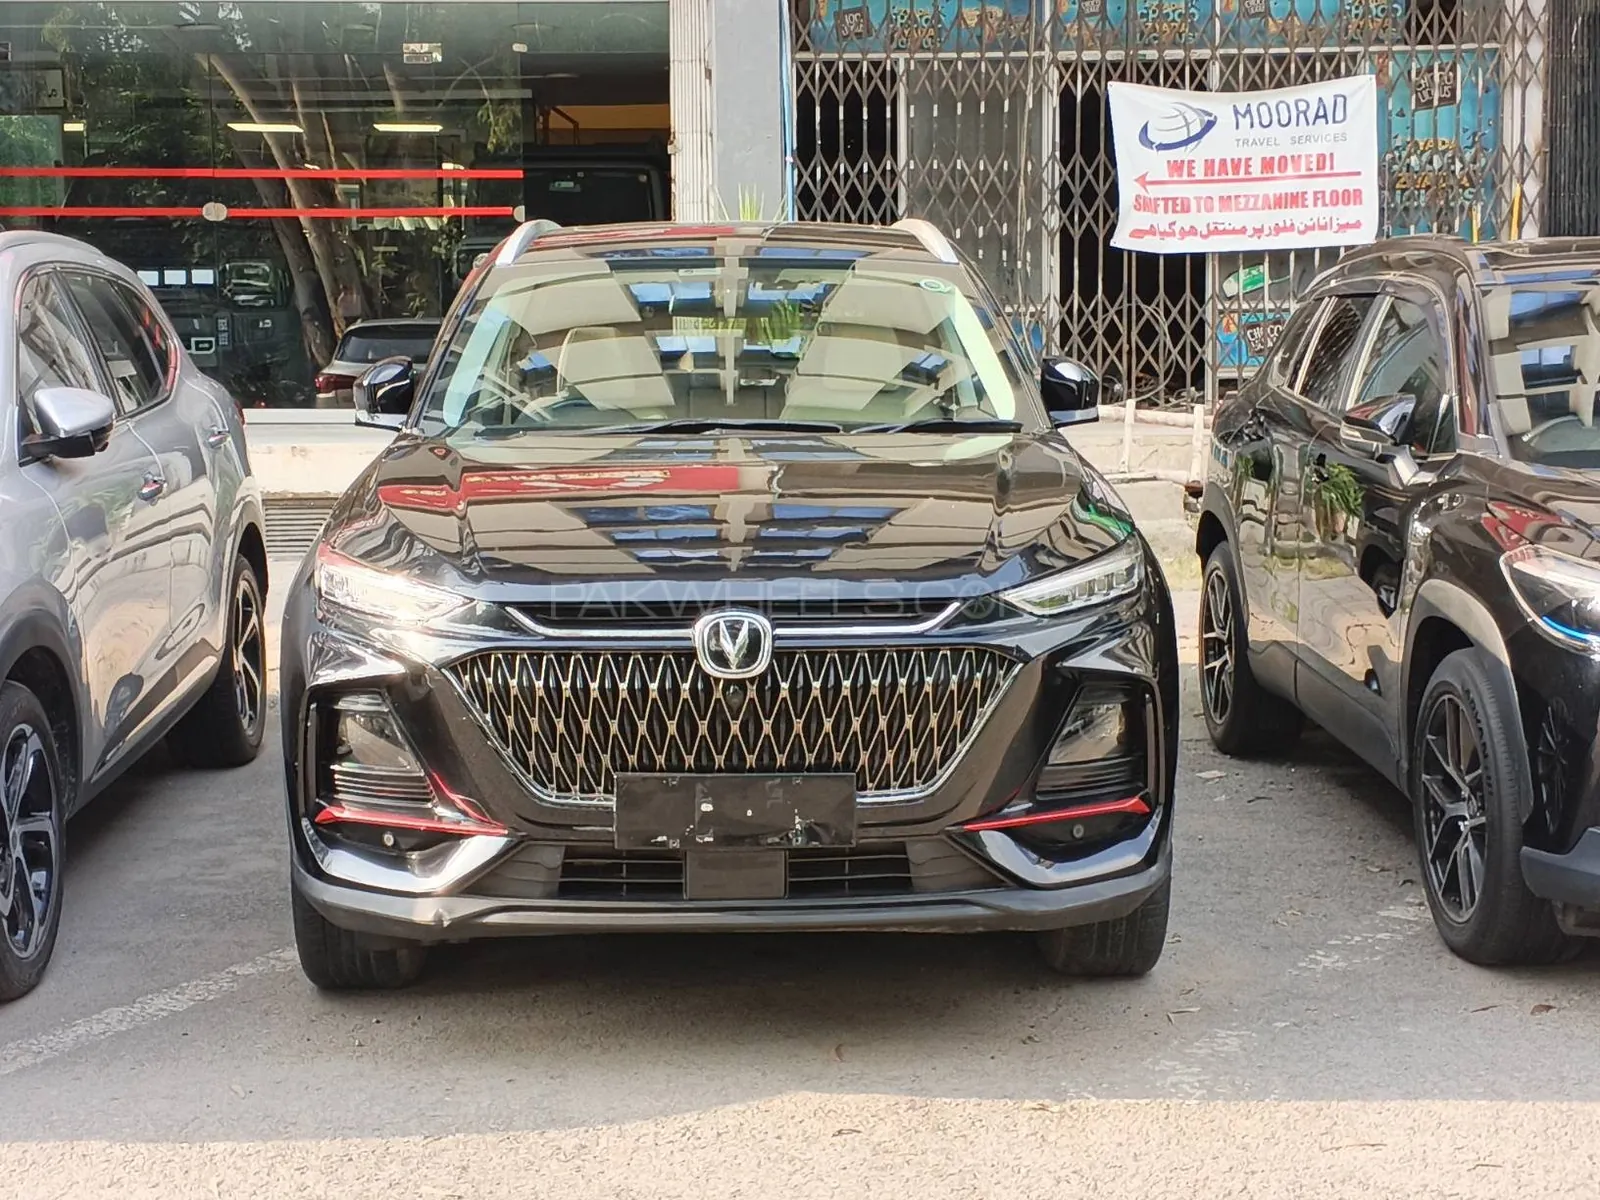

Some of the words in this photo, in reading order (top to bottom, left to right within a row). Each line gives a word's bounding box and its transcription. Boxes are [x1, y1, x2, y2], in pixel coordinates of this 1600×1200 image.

[1233, 94, 1347, 130] MOORAD
[1235, 137, 1280, 148] TRAVEL
[1290, 132, 1347, 145] SERVICES
[1166, 159, 1196, 178] WE
[1204, 156, 1252, 177] HAVE
[1193, 195, 1214, 213] TO
[1218, 190, 1308, 213] MEZZANINE
[1312, 188, 1363, 208] FLOOR
